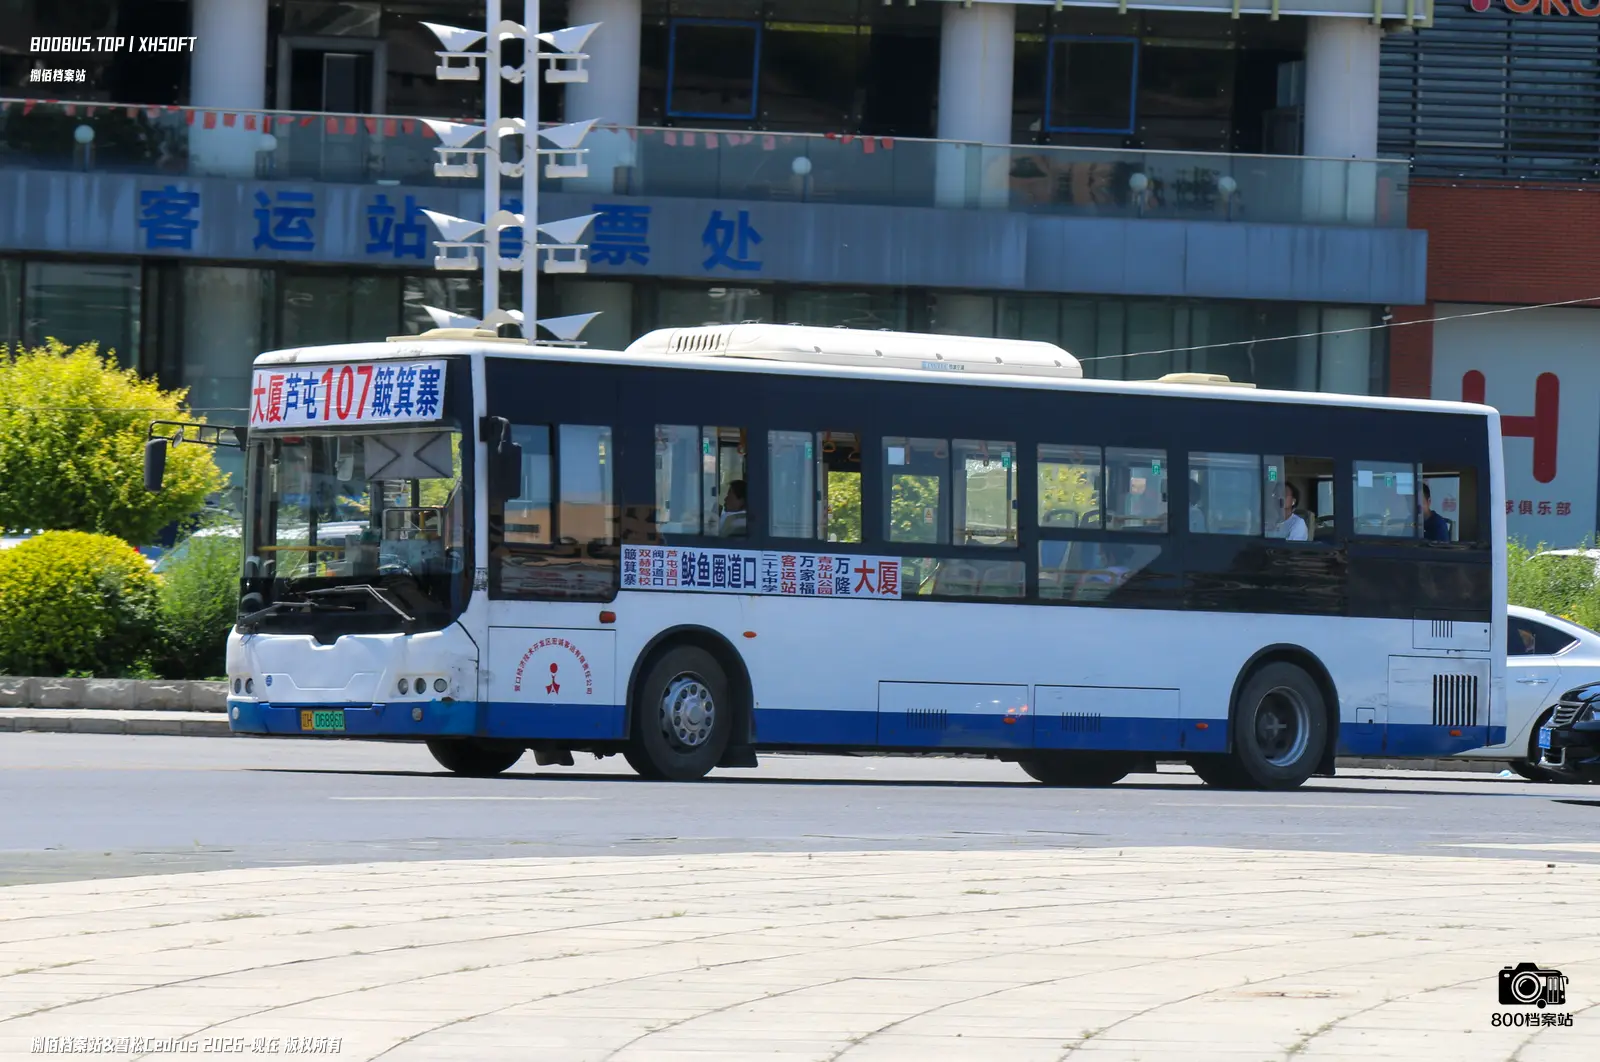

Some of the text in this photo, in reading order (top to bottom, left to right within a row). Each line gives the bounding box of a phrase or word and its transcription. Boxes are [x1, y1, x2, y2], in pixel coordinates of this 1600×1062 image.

[681, 551, 757, 589] 鲅鱼圈道口
[781, 555, 797, 594] 客运站
[799, 555, 816, 595] 万家福
[854, 559, 899, 596] 大厦
